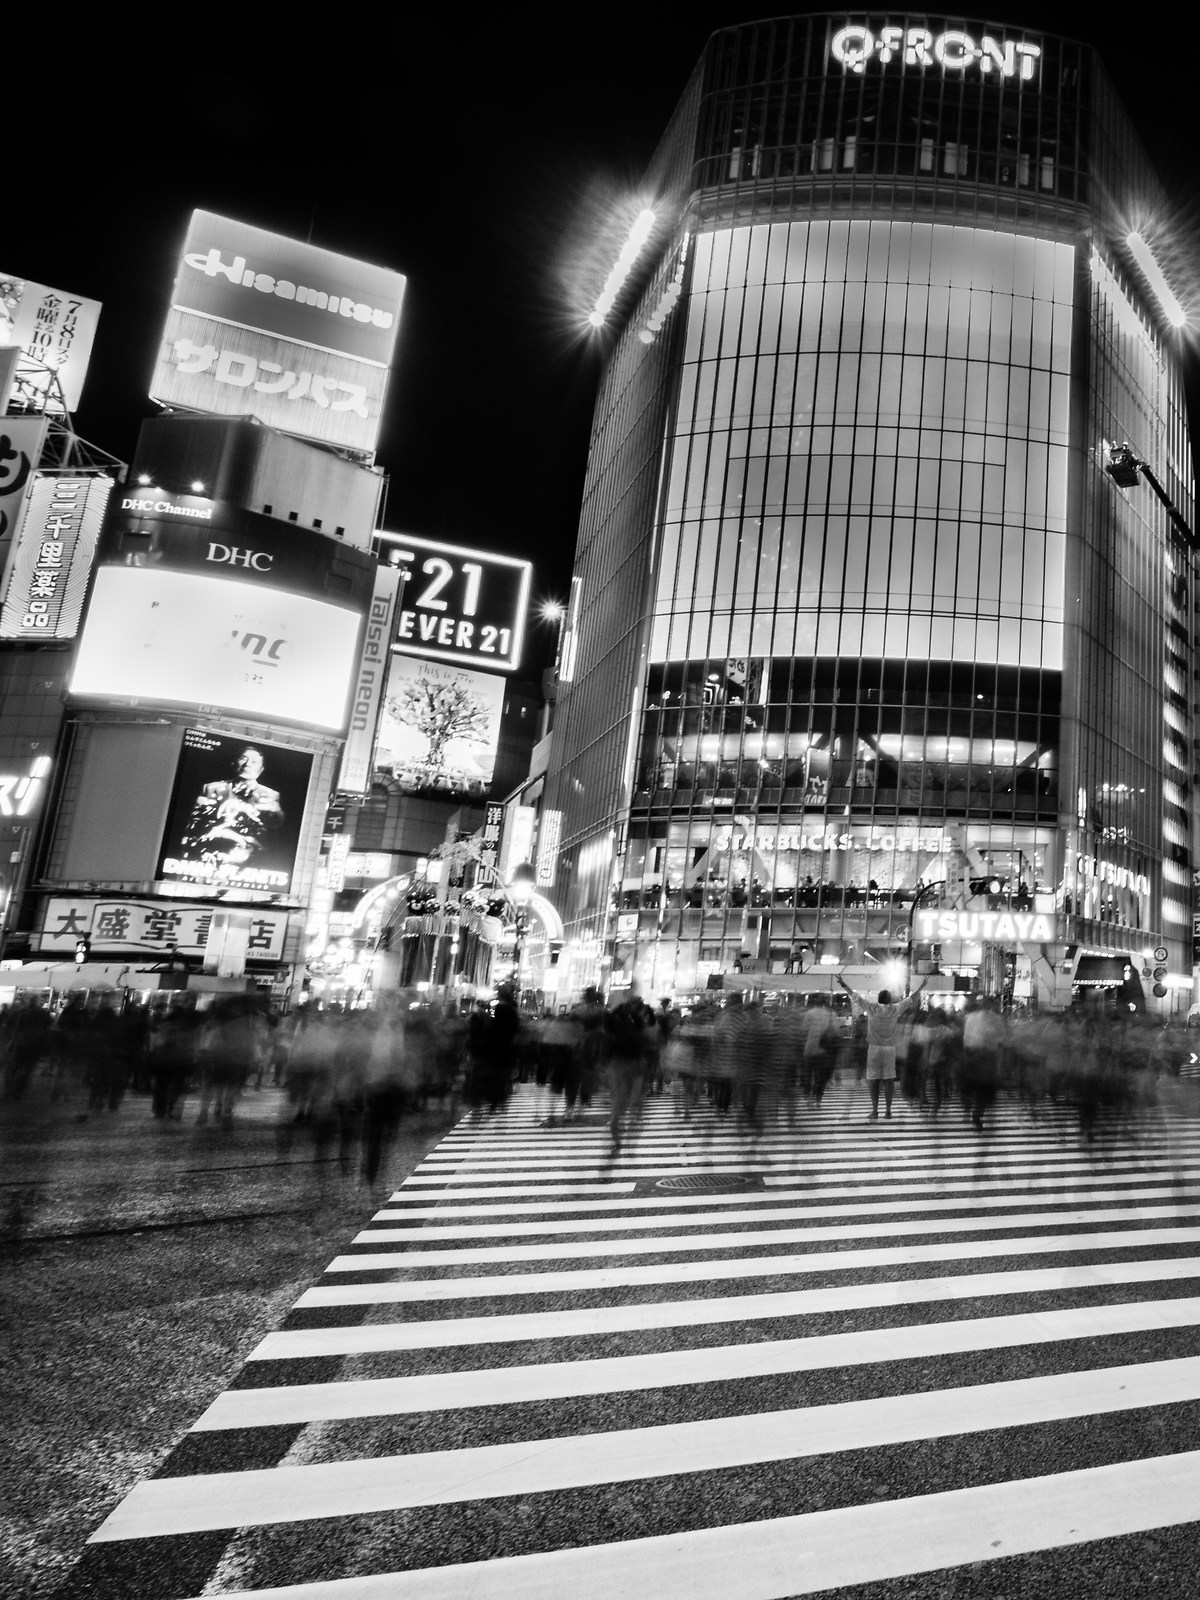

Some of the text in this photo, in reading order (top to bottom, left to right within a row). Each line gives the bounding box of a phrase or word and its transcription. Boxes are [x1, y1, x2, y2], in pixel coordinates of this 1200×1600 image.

[832, 25, 1041, 80] QFRONT
[184, 248, 394, 329] Hisamitsu
[173, 338, 369, 418] サロンパス
[121, 497, 214, 520] DHC Channel
[22, 483, 81, 628] 三千里薬品
[206, 542, 274, 572] DHC
[363, 592, 394, 664] Taisei
[479, 624, 512, 656] 21
[352, 670, 376, 732] neon
[713, 832, 953, 853] STARBUCKS COFFEE
[918, 912, 1052, 940] TSUTAYA
